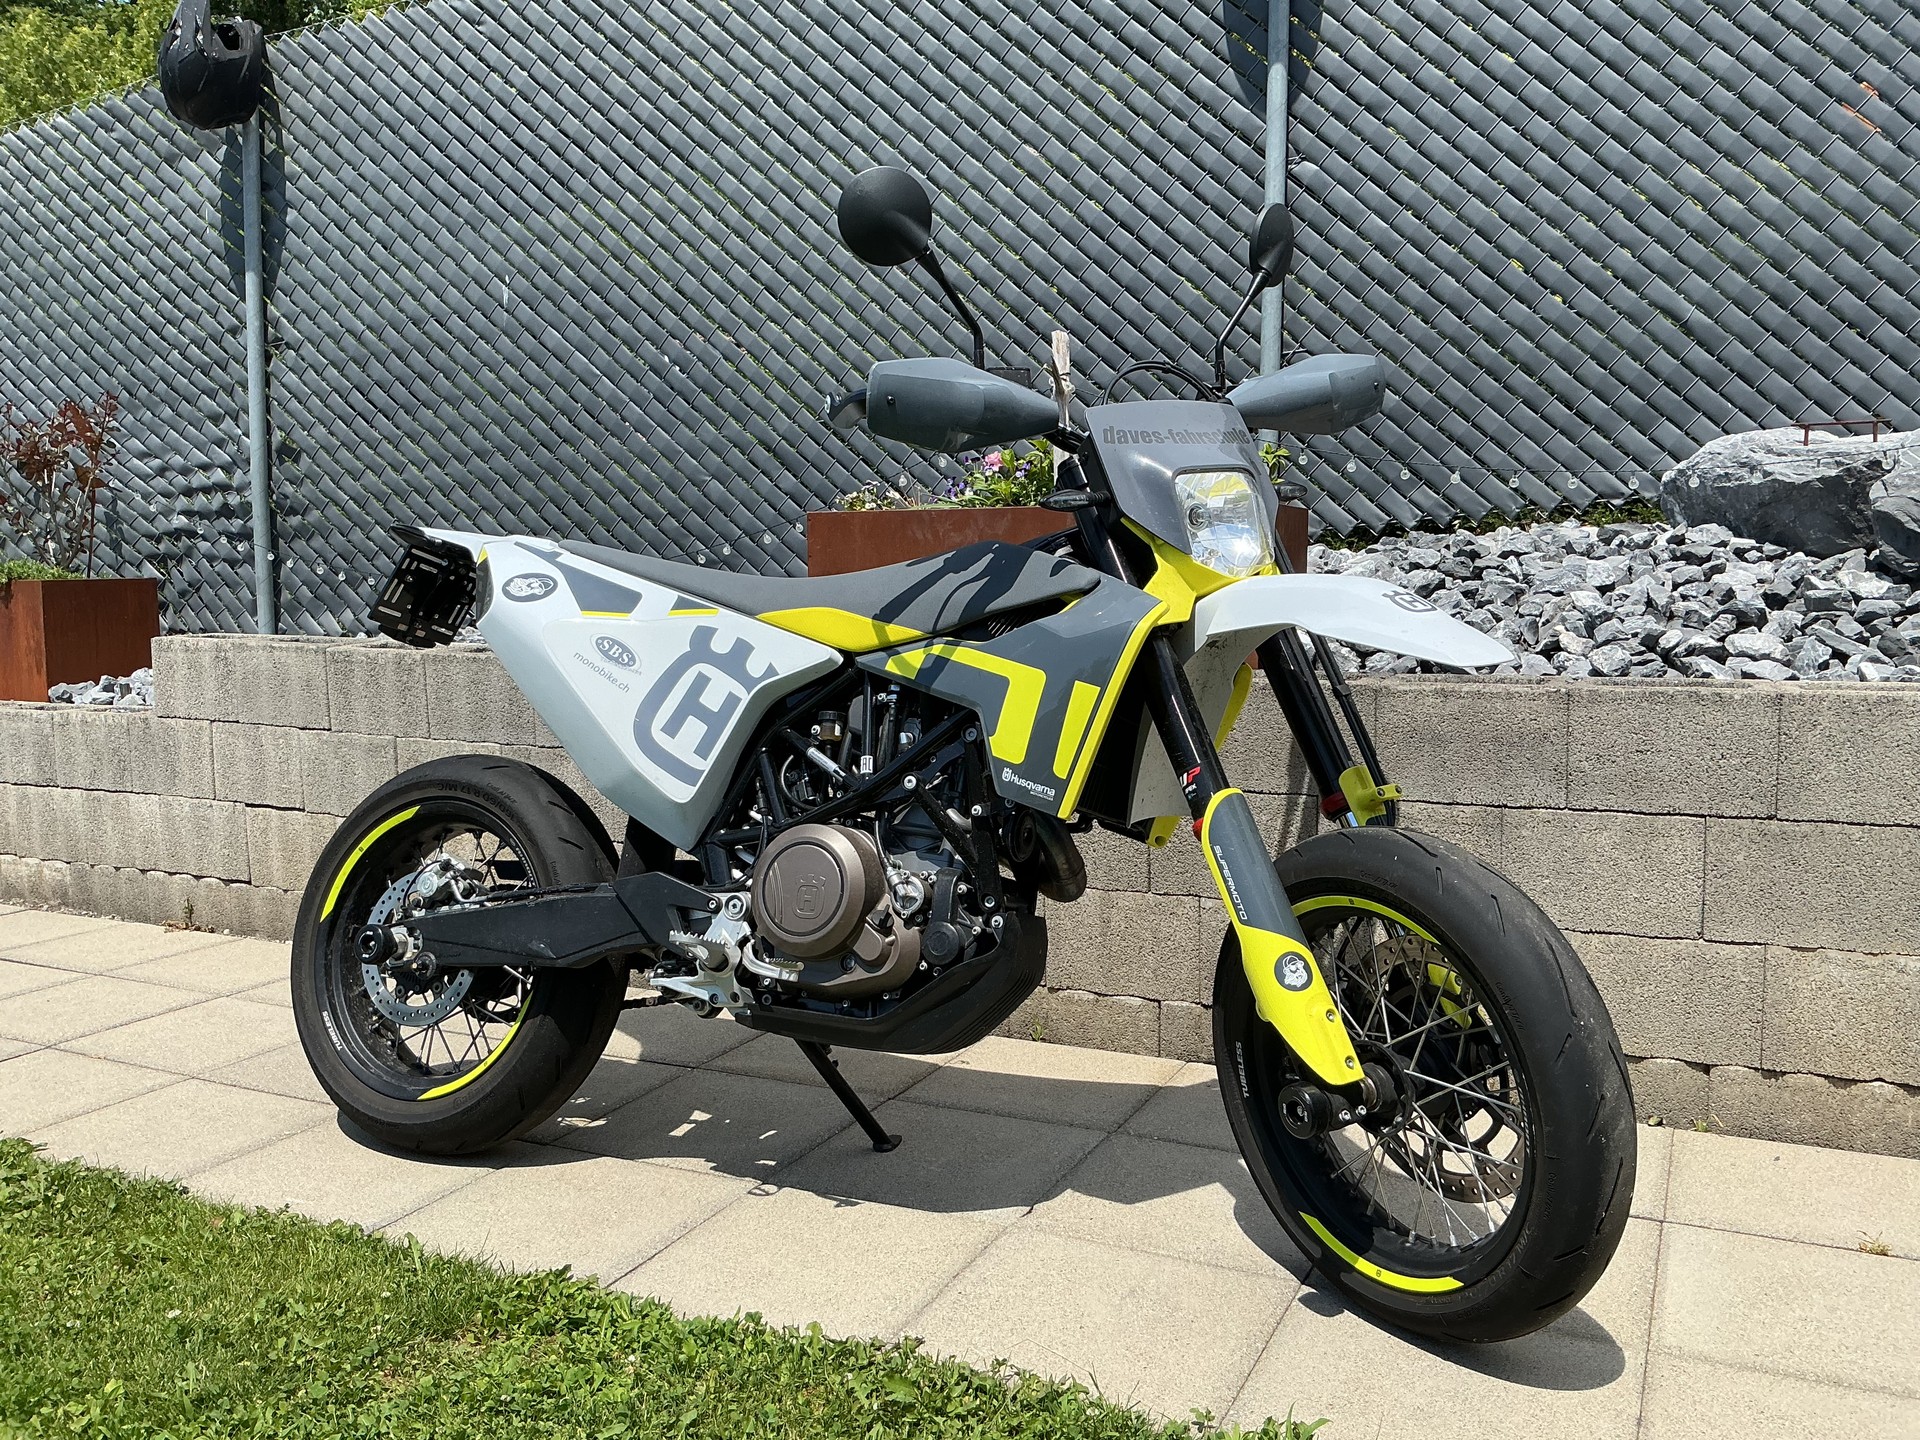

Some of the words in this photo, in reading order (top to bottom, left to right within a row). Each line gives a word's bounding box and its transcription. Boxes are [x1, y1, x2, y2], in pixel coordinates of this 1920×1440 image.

[599, 639, 632, 664] SBS
[573, 652, 630, 693] monobike.ch
[1010, 773, 1056, 796] Husqvarna
[1213, 845, 1248, 920] SUPERMOTO
[322, 1010, 343, 1051] TUBELESS
[1235, 1041, 1250, 1099] TUBELESS
